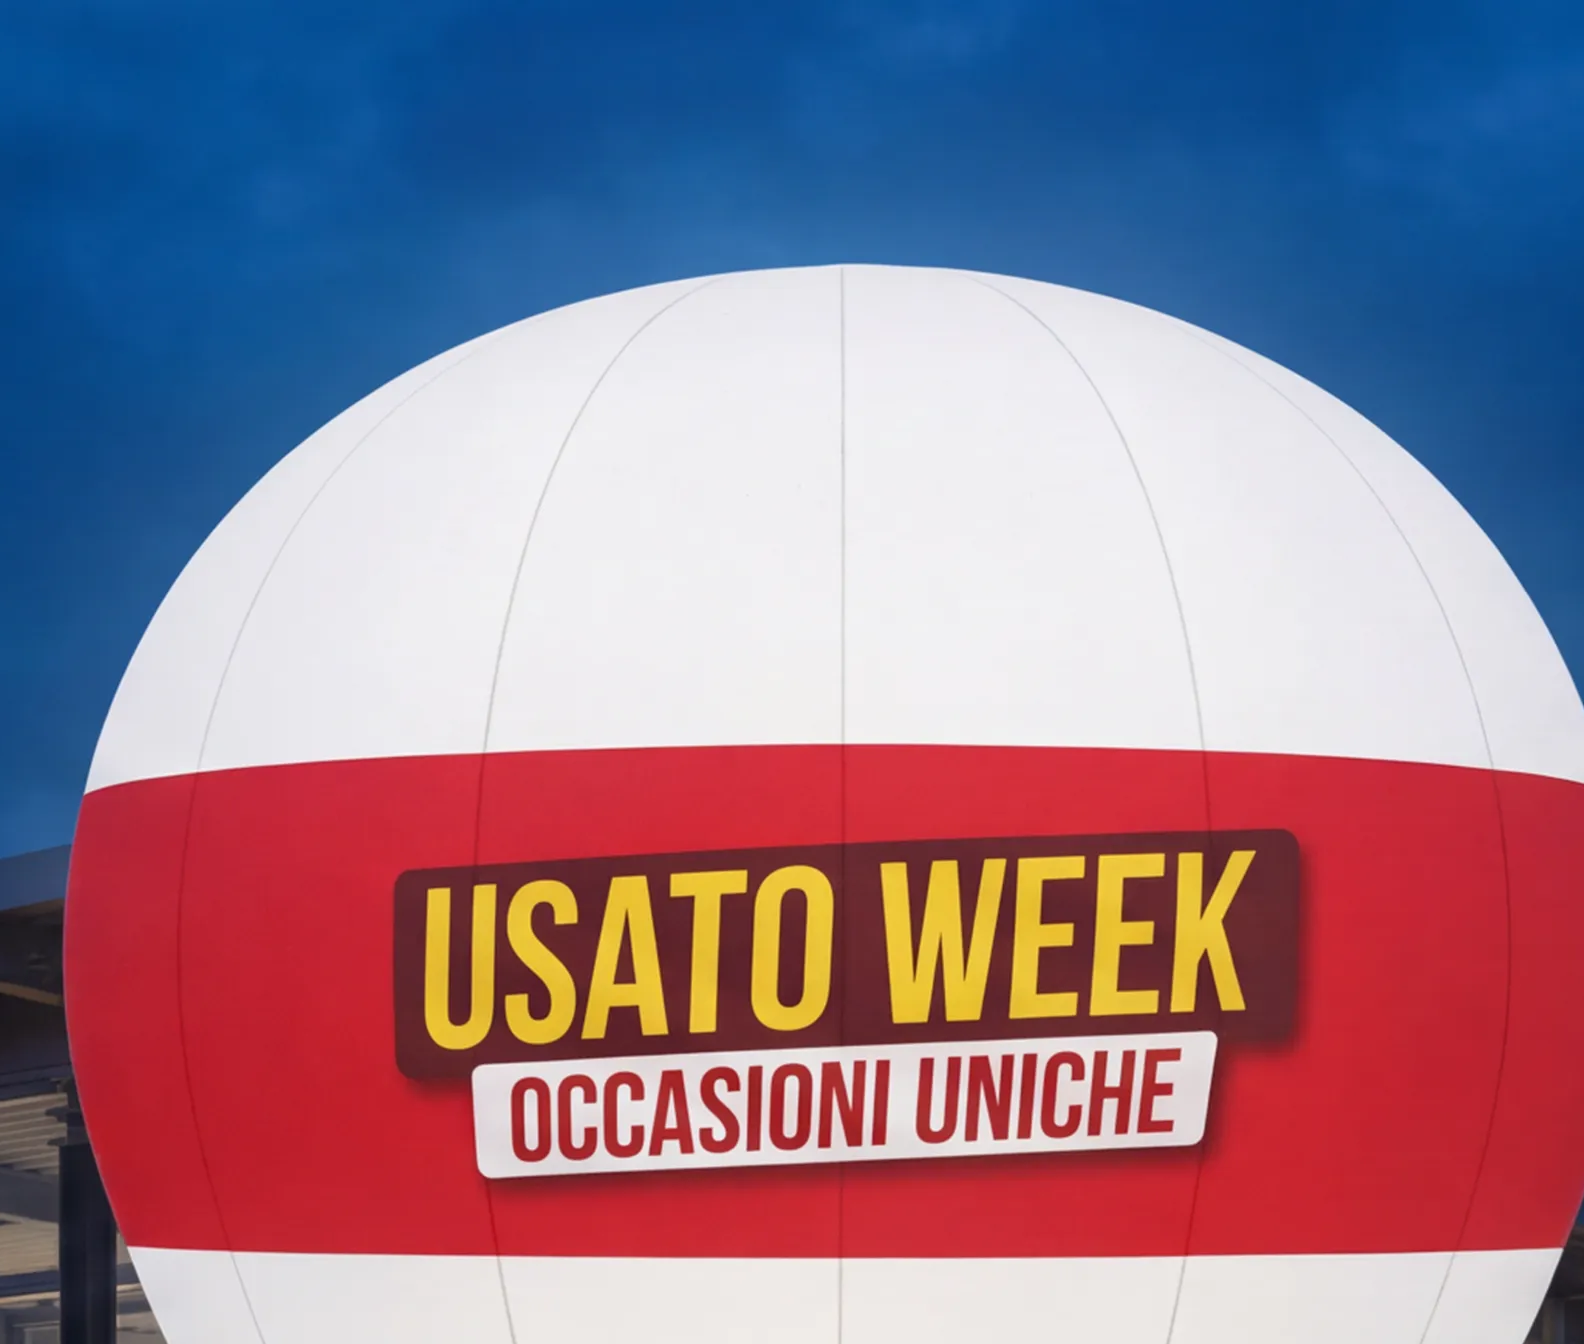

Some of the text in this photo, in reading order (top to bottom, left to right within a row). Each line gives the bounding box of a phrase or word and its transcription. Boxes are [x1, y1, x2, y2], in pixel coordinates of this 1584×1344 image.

[424, 850, 1256, 1050] USATO WEEK
[510, 1047, 1183, 1163] OCCASIONI UNICHE
